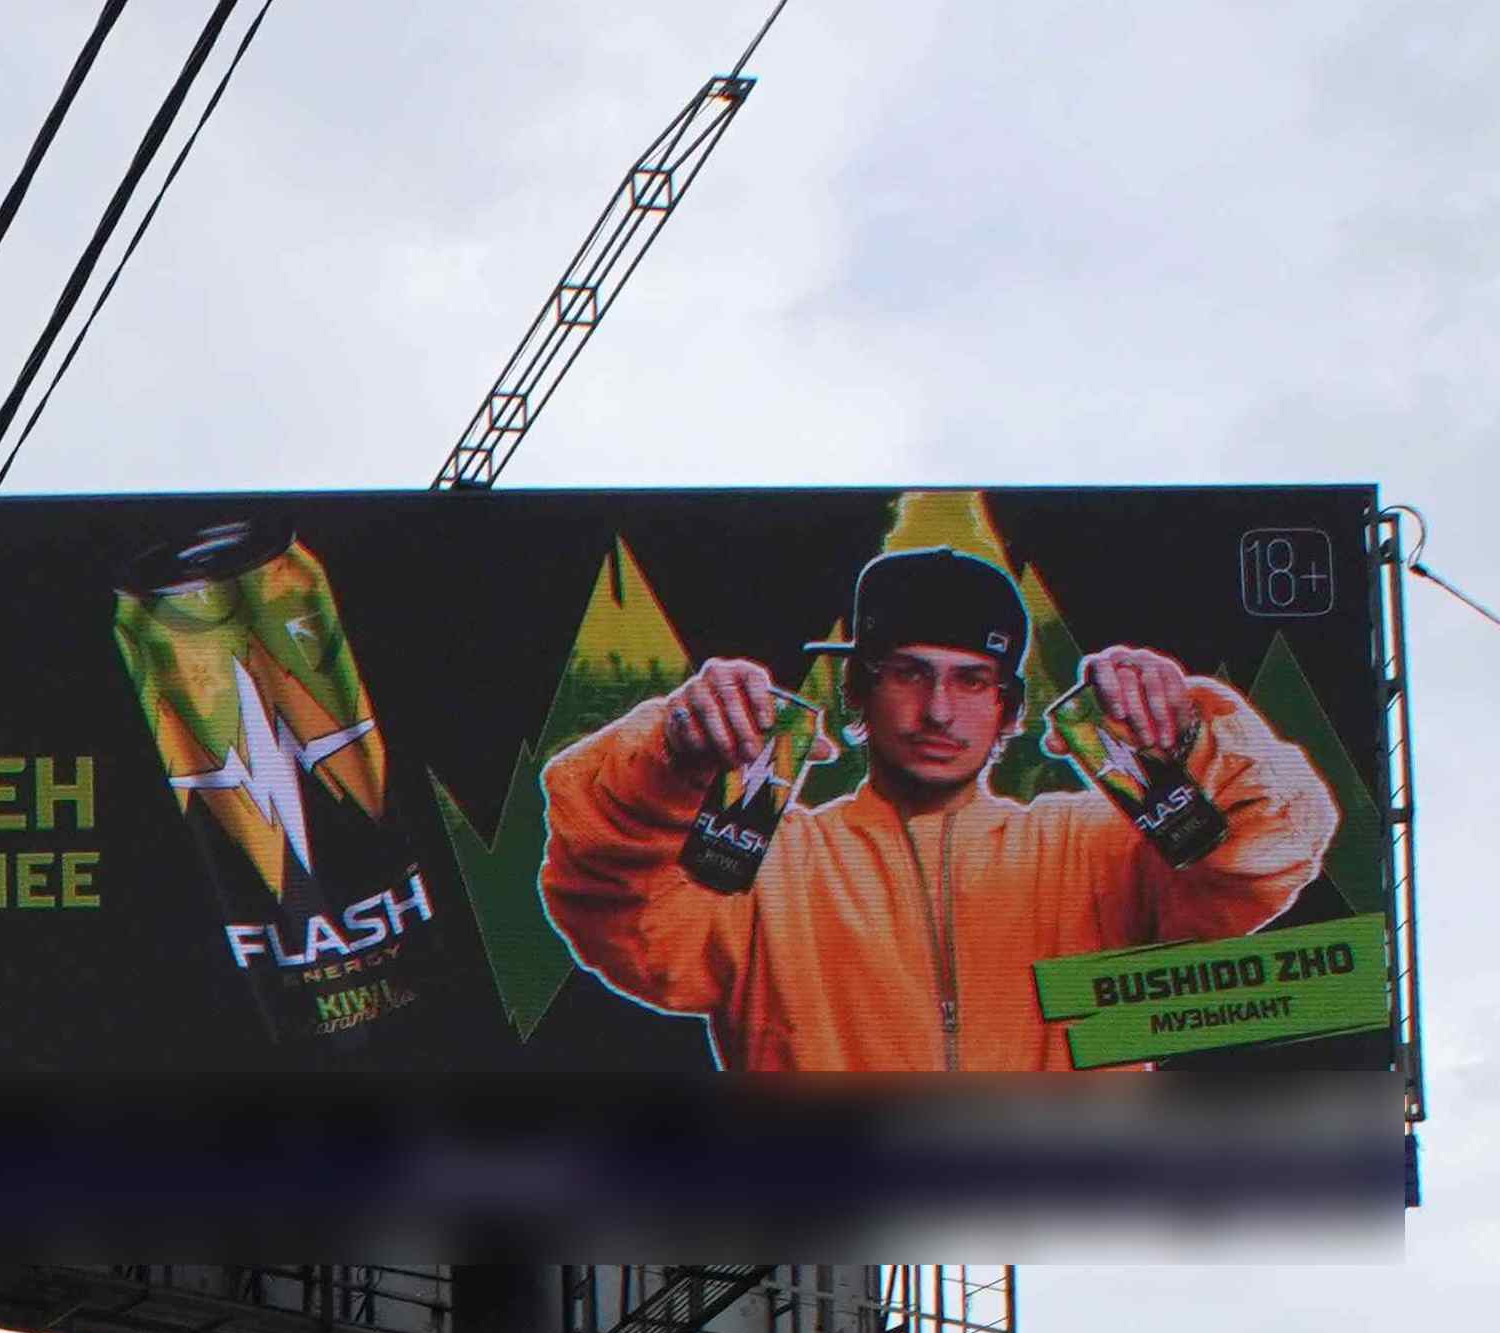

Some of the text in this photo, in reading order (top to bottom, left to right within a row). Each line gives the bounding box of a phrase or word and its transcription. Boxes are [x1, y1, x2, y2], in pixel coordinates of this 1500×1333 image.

[1245, 538, 1328, 607] 18+
[225, 874, 432, 969] FLASH
[1092, 944, 1353, 1007] BUSHIDO ZHO
[1150, 996, 1291, 1033] МУЗЫКАНТ
